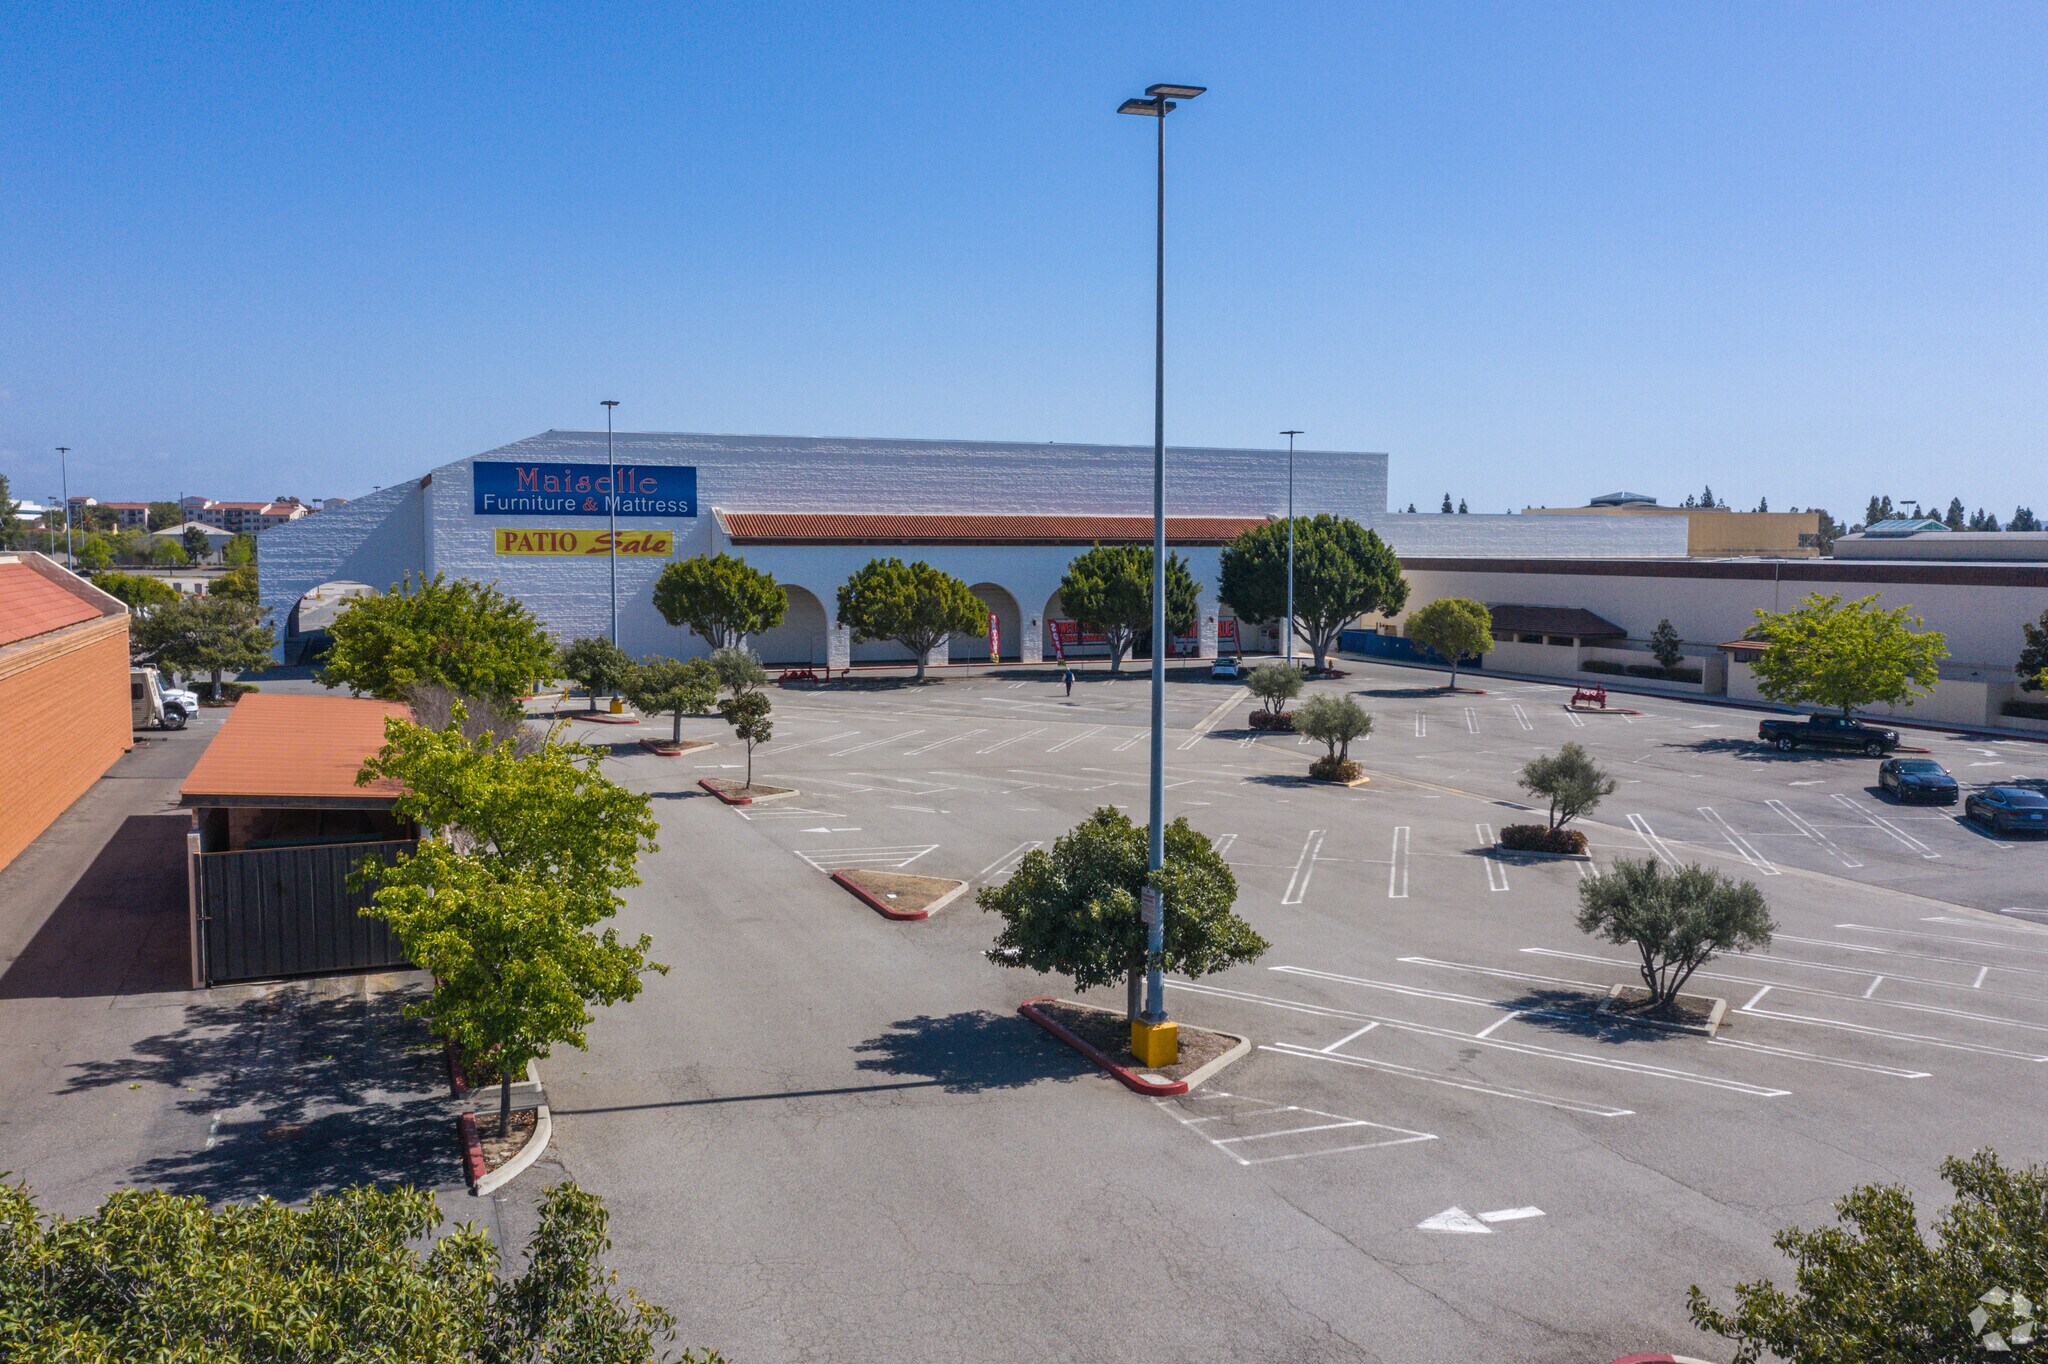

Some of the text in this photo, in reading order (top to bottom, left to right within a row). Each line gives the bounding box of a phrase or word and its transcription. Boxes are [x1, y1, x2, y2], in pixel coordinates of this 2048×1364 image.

[516, 467, 658, 494] Maiselle
[484, 494, 688, 513] Furniture & Mattress
[503, 531, 667, 554] PATIO Sale
